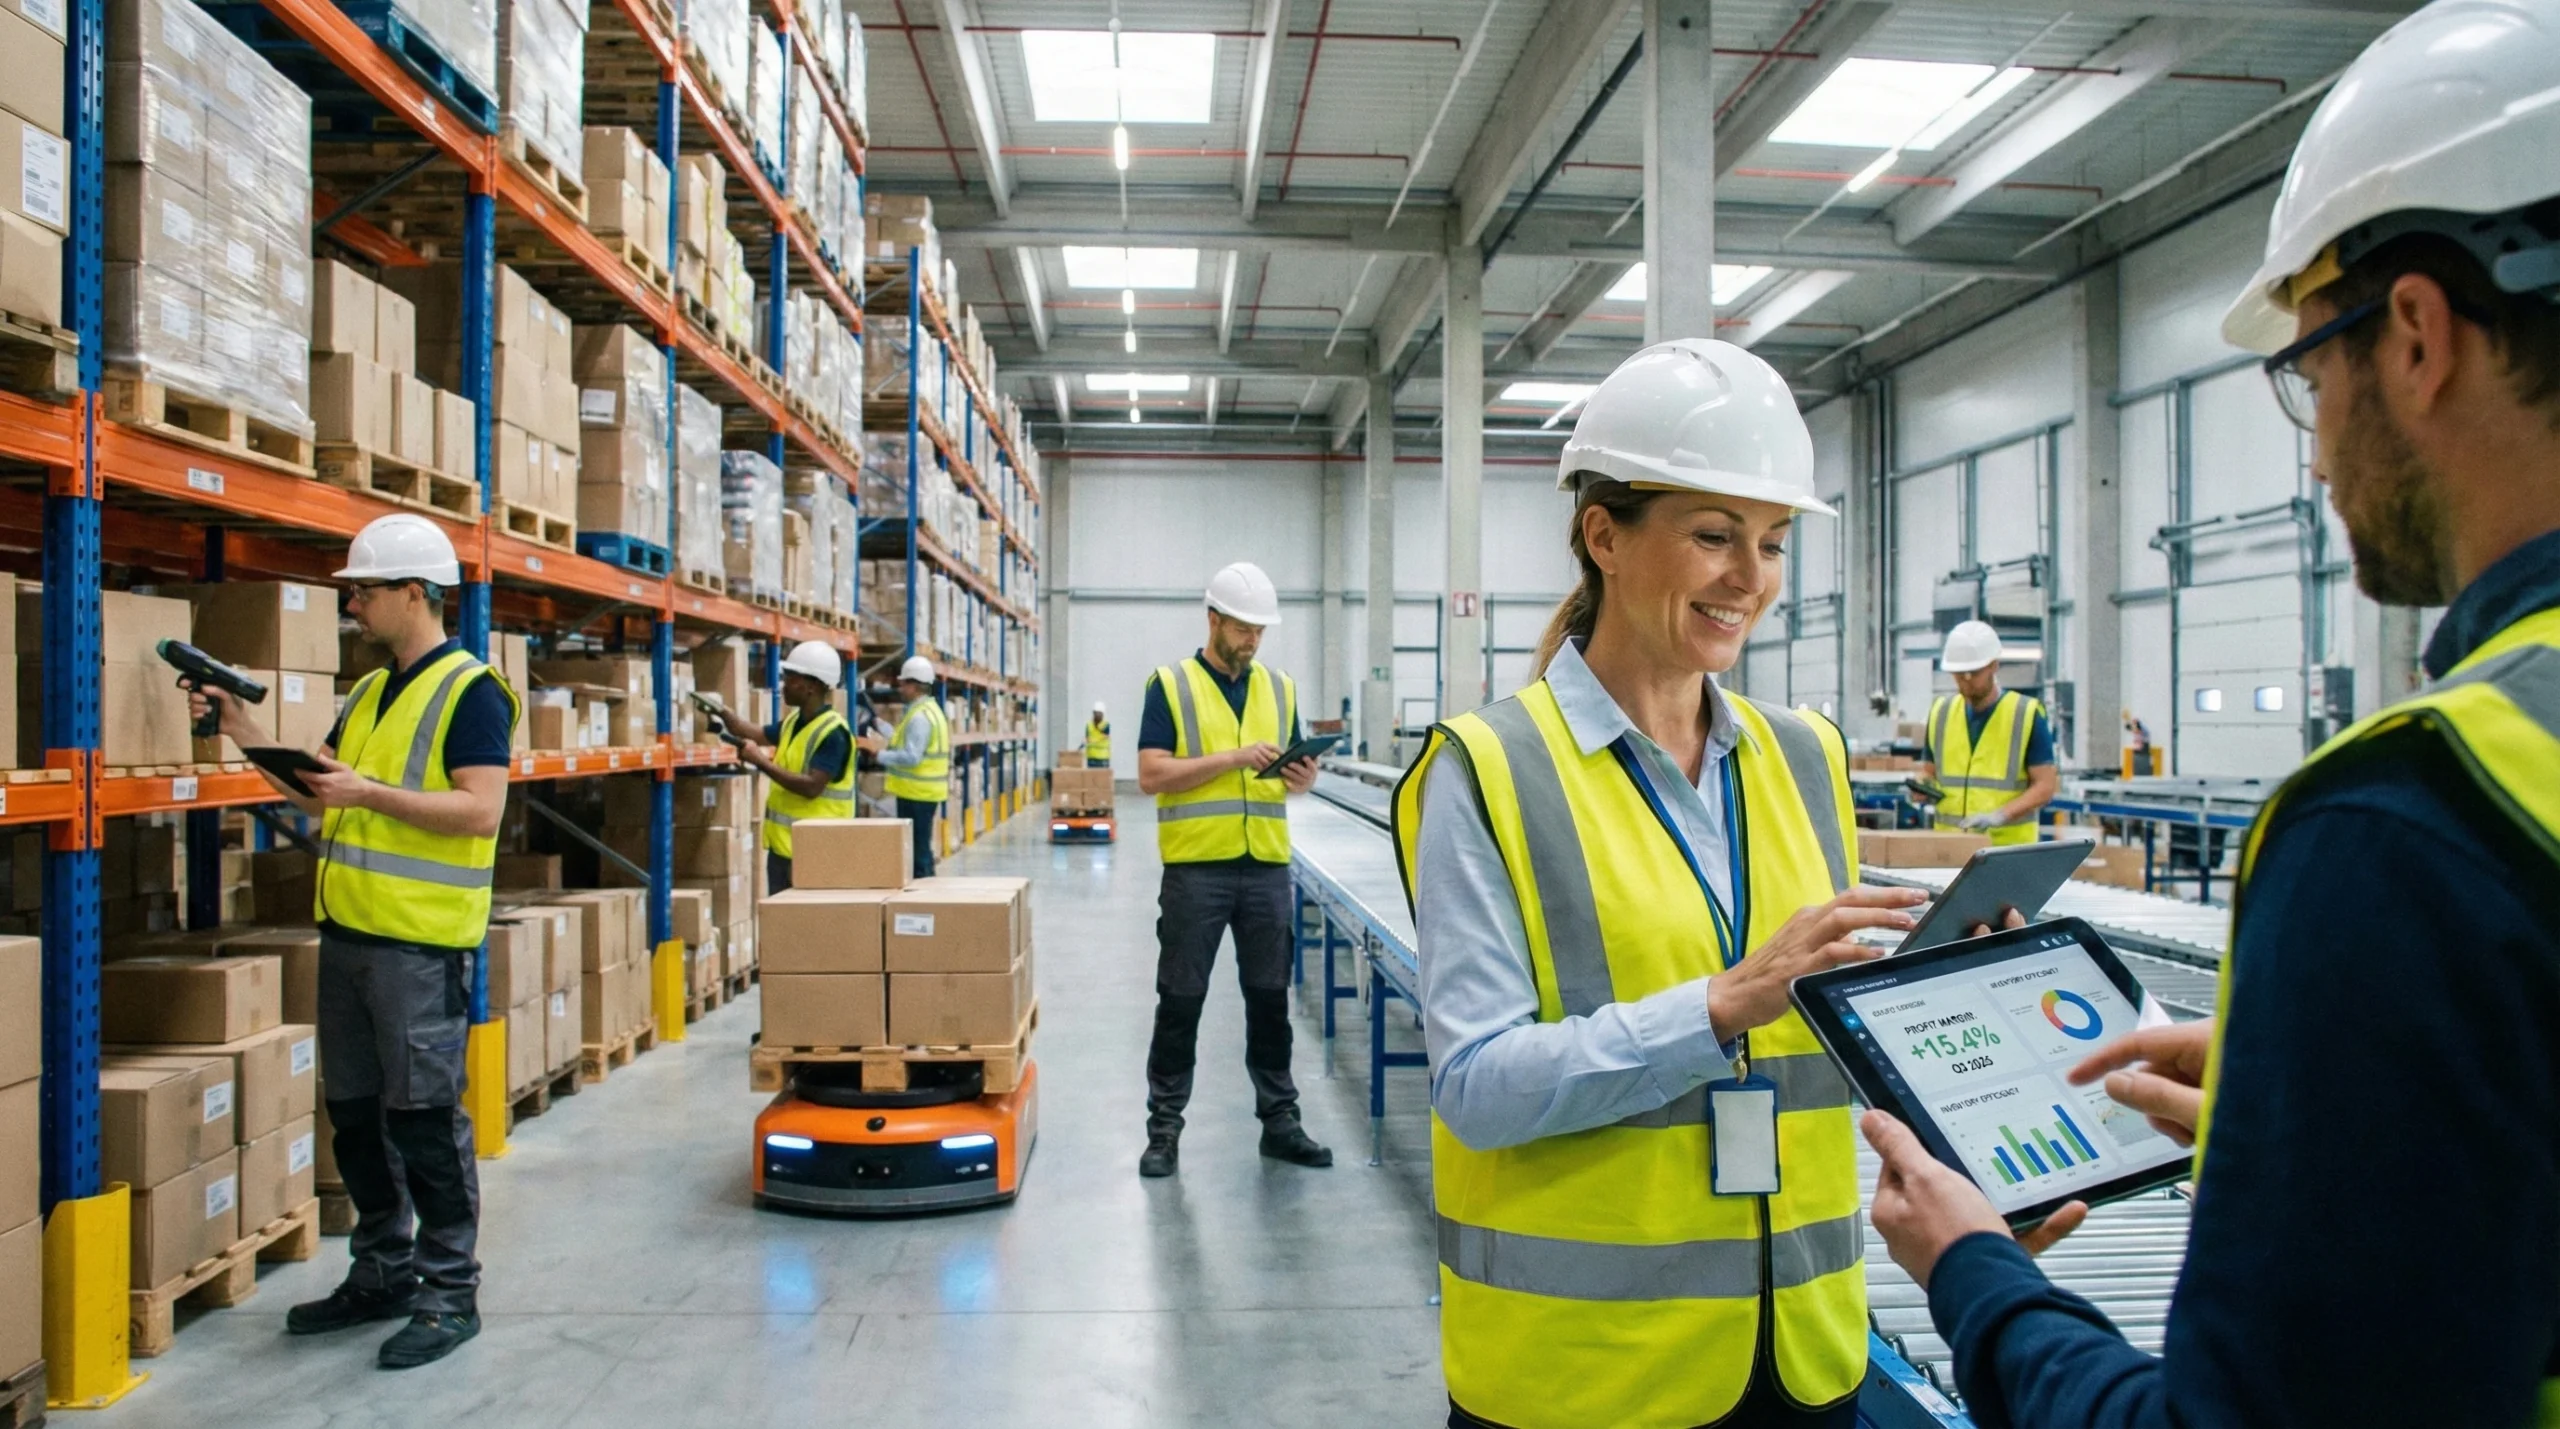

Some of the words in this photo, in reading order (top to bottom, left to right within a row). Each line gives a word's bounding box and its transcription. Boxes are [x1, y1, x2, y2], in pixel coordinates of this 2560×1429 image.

[1904, 1020, 1936, 1036] PROFIT
[1911, 1024, 2001, 1060] +15.4%
[1967, 1055, 1994, 1071] 2025
